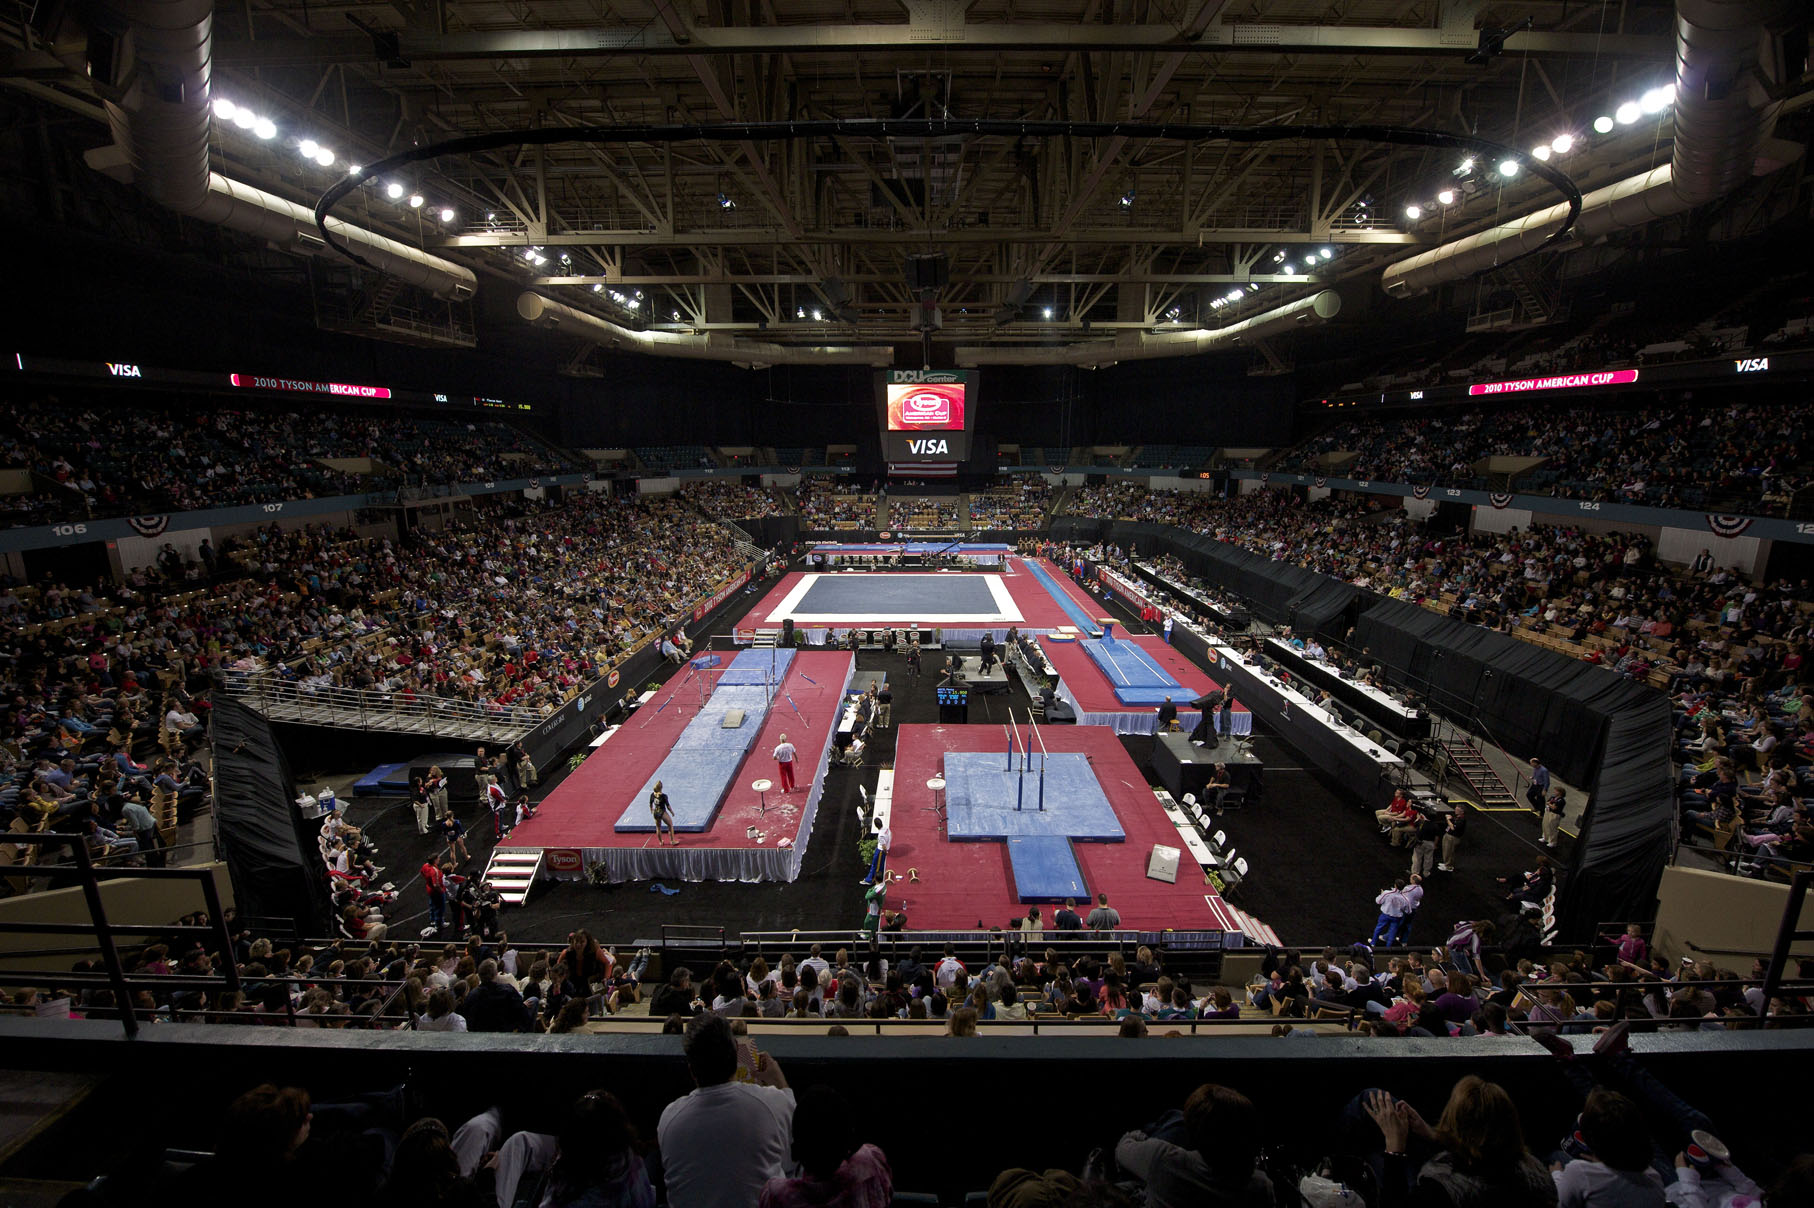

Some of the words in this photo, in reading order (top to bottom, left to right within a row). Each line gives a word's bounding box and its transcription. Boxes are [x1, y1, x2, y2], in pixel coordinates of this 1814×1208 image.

[105, 362, 142, 377] VISA
[1734, 358, 1769, 372] VISA
[894, 370, 924, 383] DCU
[926, 375, 957, 383] center
[1484, 384, 1502, 393] 2010
[1504, 381, 1534, 391] TYSON
[1535, 375, 1589, 389] AMERICAN
[1591, 373, 1614, 384] CUP
[253, 377, 277, 388] 2010
[279, 380, 312, 391] TYSON
[315, 383, 360, 395] AMERICAN
[361, 387, 377, 396] CUP
[433, 393, 448, 403] VISA
[1410, 391, 1424, 400] VISA
[906, 439, 949, 454] VISA
[1446, 489, 1461, 497] 123
[262, 503, 284, 513] 107
[1578, 501, 1601, 511] 124
[51, 523, 88, 537] 106
[551, 854, 577, 865] Tyson
